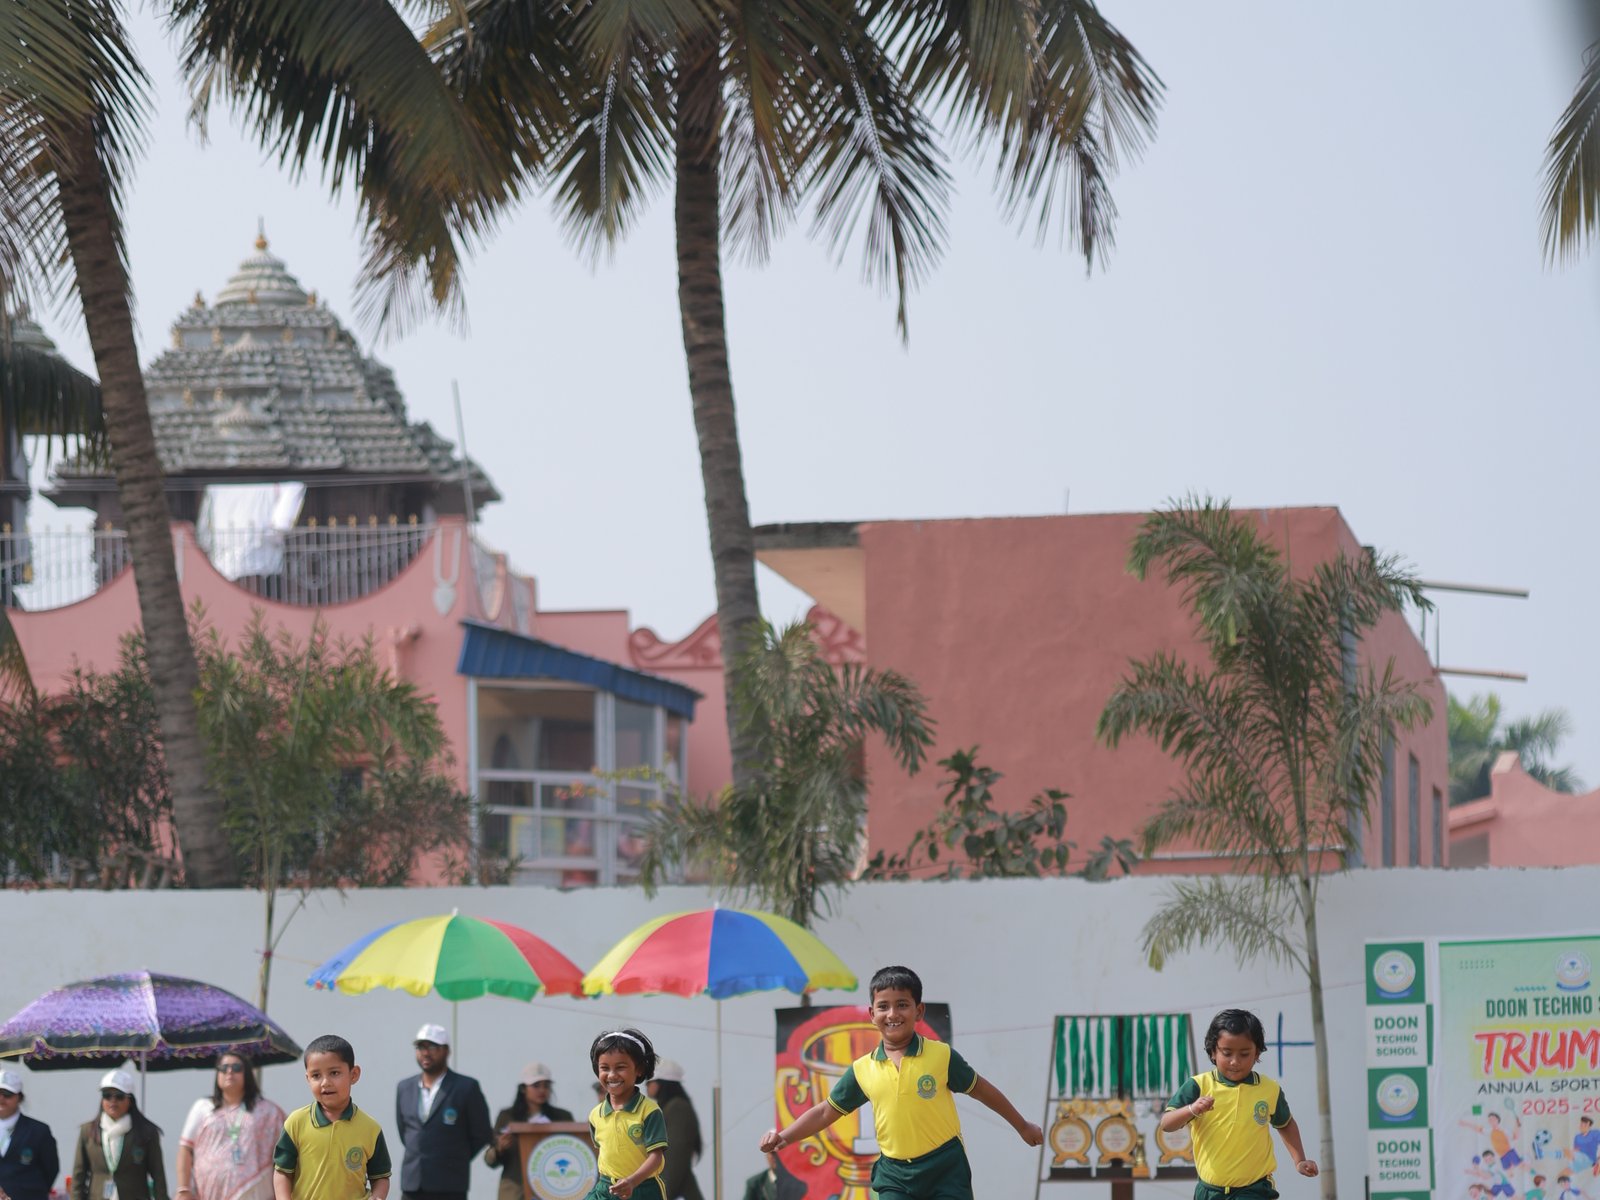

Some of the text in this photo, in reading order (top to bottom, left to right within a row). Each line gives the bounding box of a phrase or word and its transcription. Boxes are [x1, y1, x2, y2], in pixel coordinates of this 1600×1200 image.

[1486, 998, 1527, 1018] DOON
[1533, 995, 1593, 1016] TECHNO
[1374, 1016, 1418, 1030] DOON
[1375, 1033, 1418, 1044] TECHNO
[1376, 1046, 1418, 1057] SCHOOL
[1474, 1028, 1600, 1074] TRIUM
[1478, 1080, 1543, 1095] ANNUAL
[1377, 1140, 1421, 1154] DOON
[1379, 1158, 1421, 1168] TECHNO
[1379, 1170, 1421, 1181] SCHOOL
